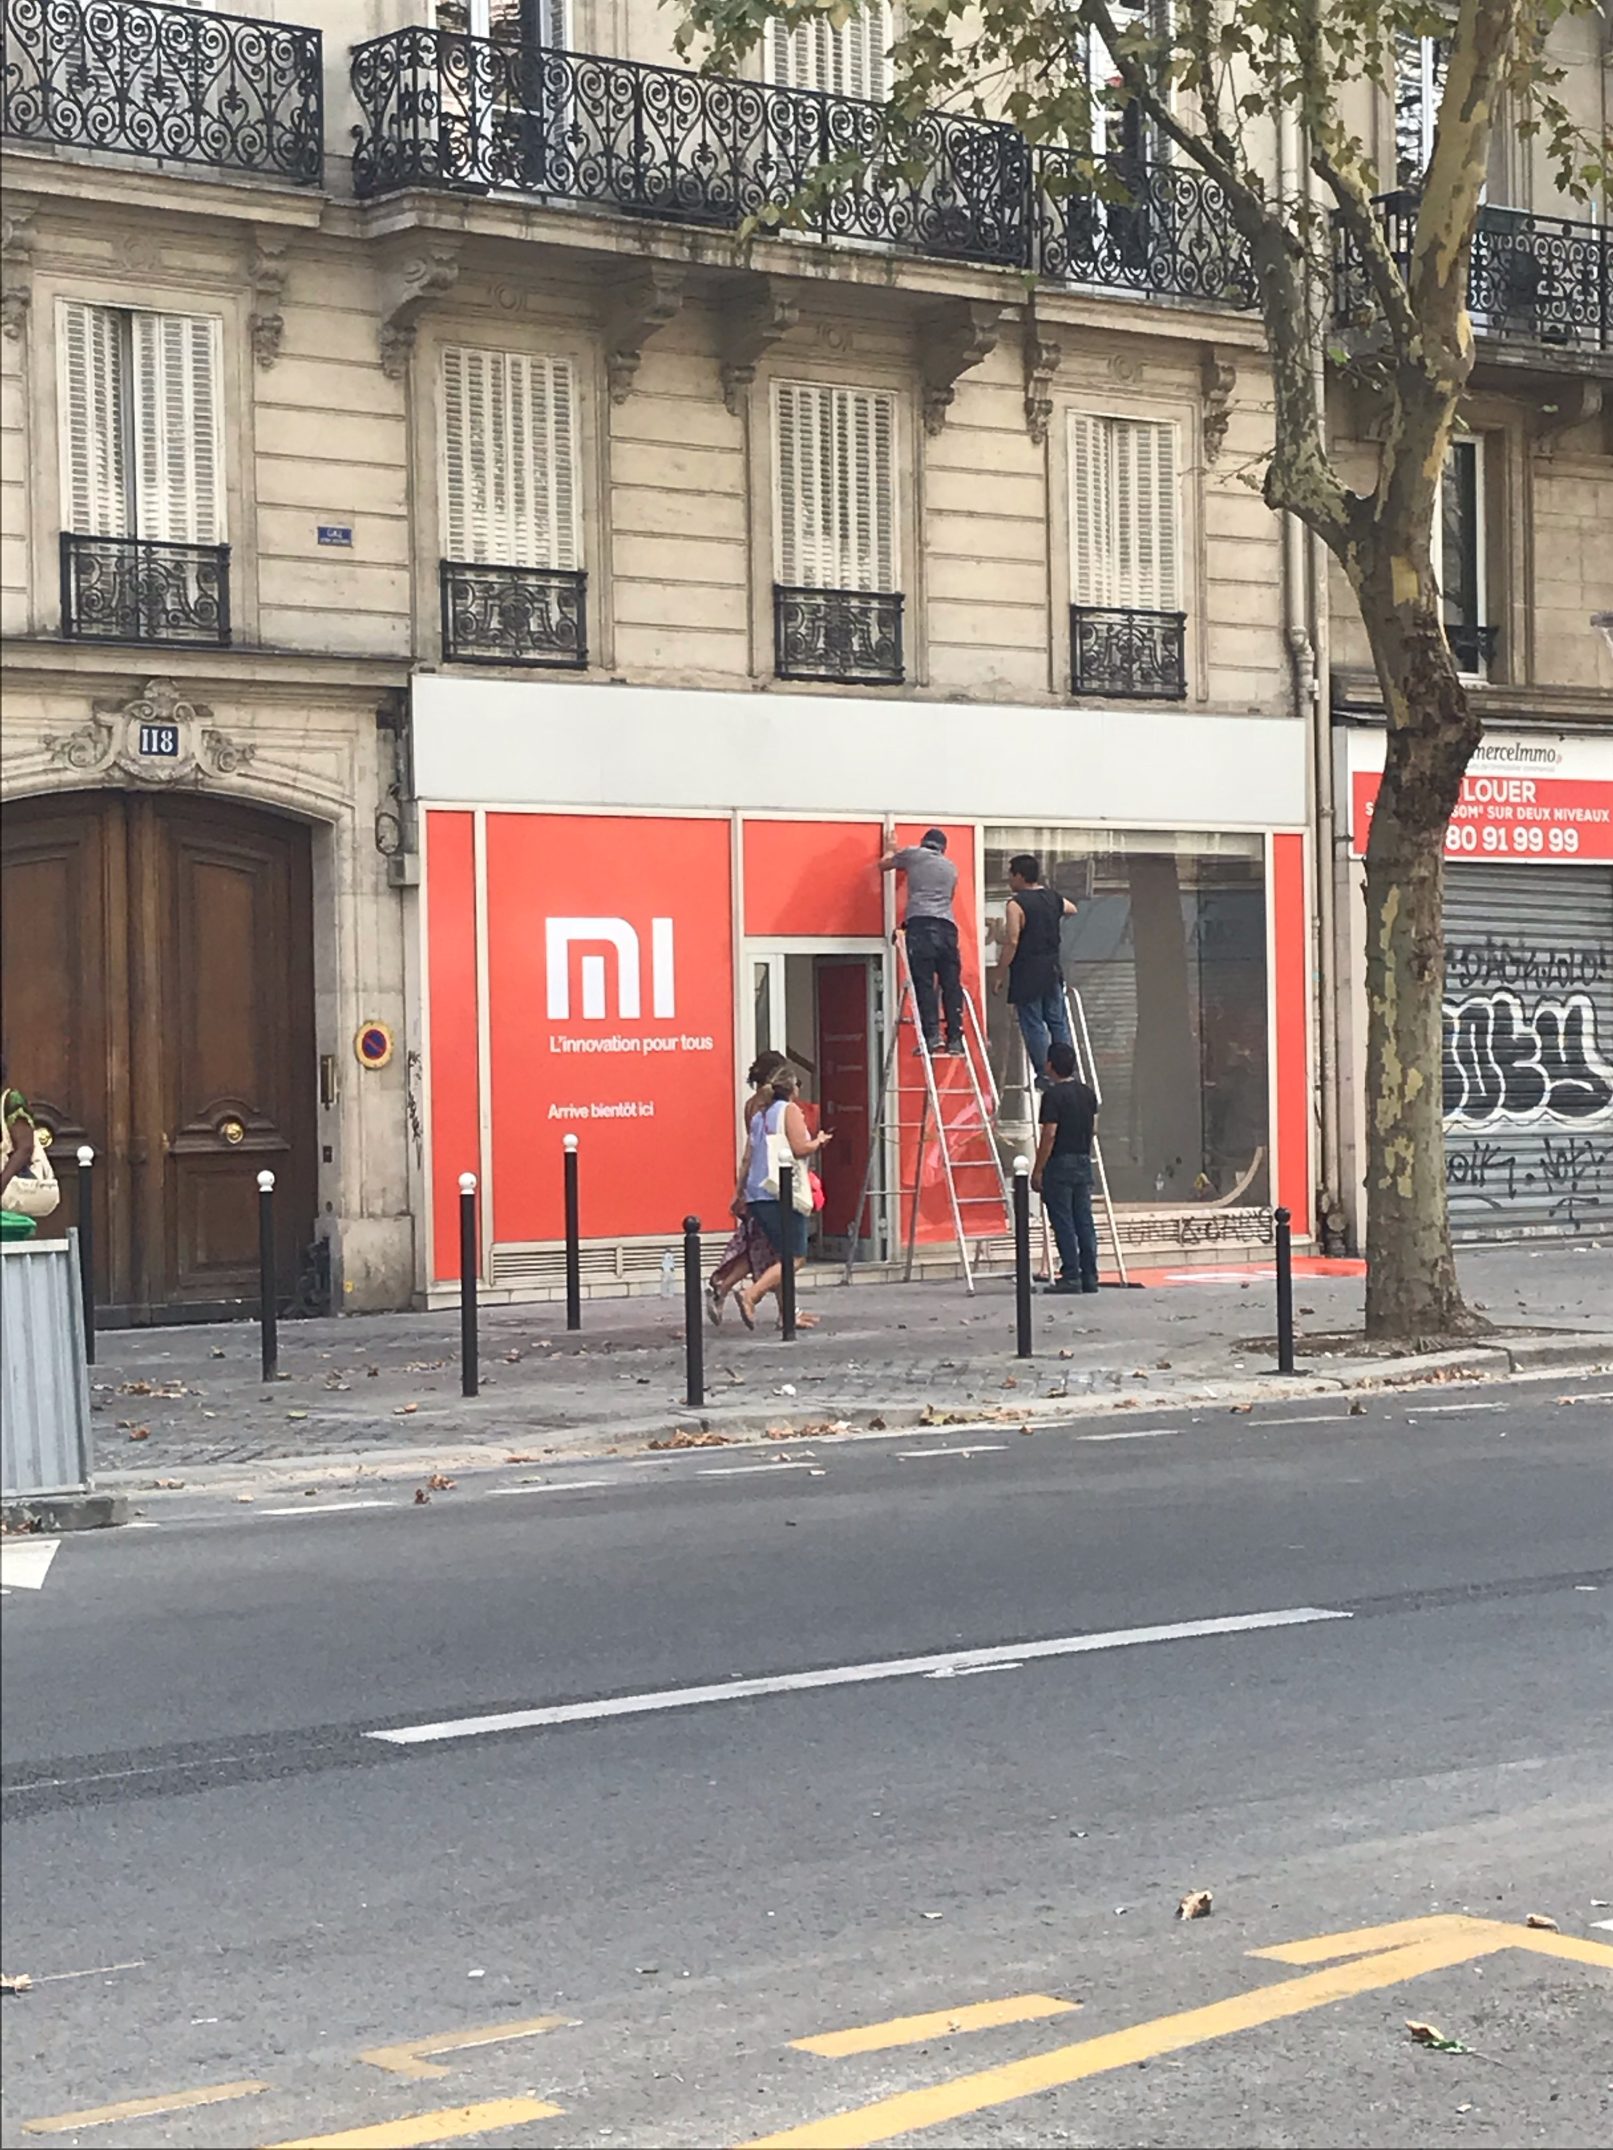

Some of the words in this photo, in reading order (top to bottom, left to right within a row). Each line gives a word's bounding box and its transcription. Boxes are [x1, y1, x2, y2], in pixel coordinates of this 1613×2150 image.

[142, 729, 173, 752] 118
[1463, 779, 1537, 804] LOUER
[1487, 805, 1514, 820] SUR
[1517, 806, 1550, 822] DEUX
[1553, 808, 1610, 823] NIVEAUX
[1446, 825, 1477, 851] 80
[1482, 826, 1509, 852] 91
[1513, 827, 1544, 852] 99
[1549, 828, 1579, 853] 99
[550, 1035, 640, 1053] L'innovation
[643, 1036, 678, 1056] pour
[680, 1034, 713, 1051] tous
[548, 1103, 588, 1120] Arrive
[591, 1101, 637, 1118] bientôt
[639, 1101, 655, 1116] ici
